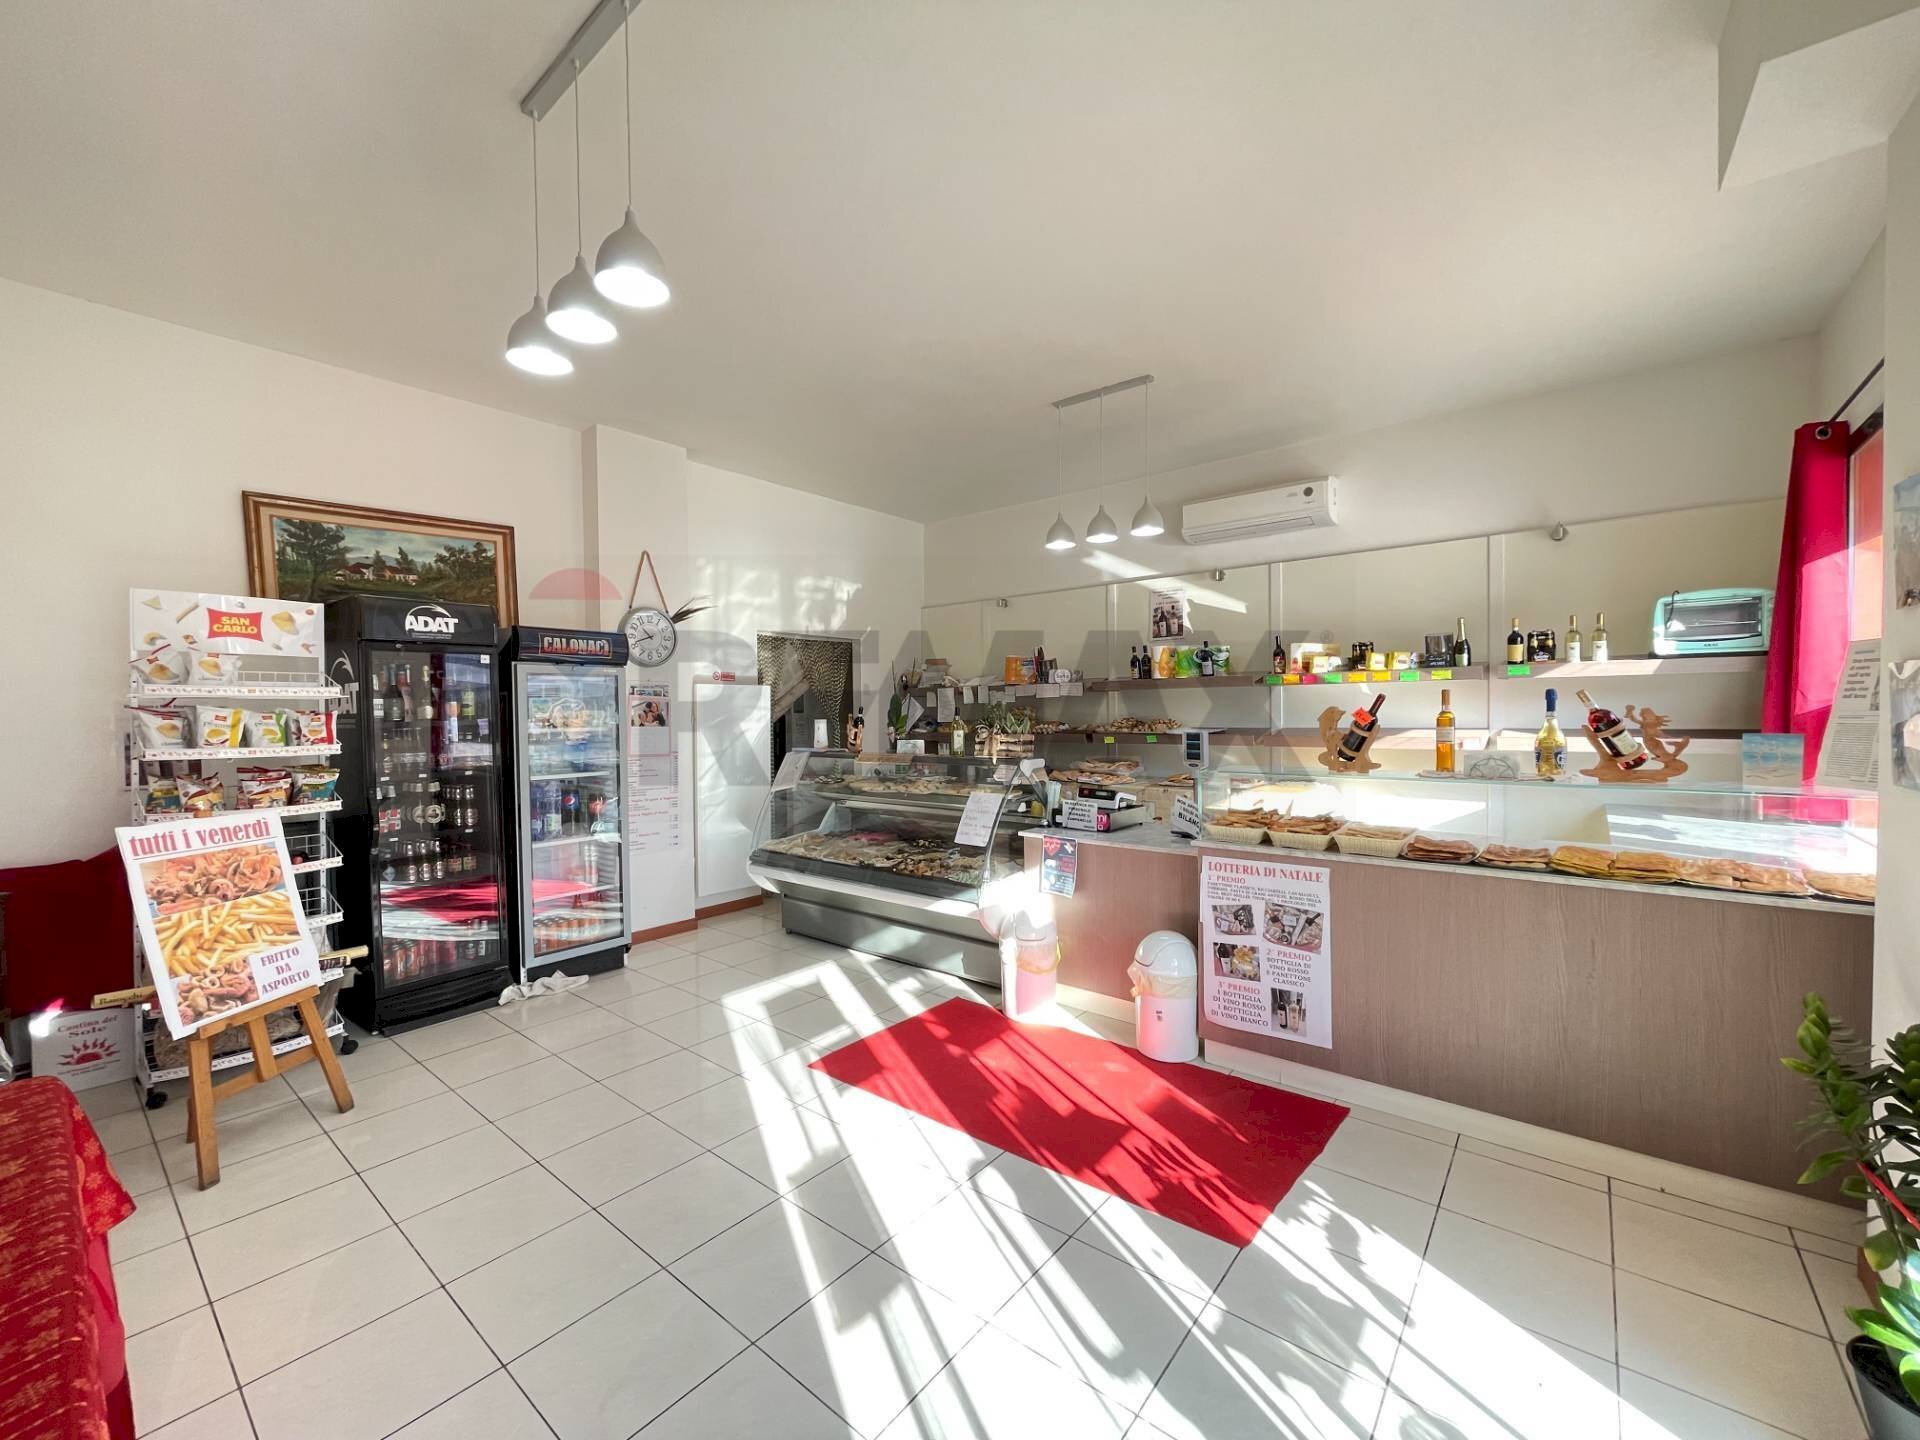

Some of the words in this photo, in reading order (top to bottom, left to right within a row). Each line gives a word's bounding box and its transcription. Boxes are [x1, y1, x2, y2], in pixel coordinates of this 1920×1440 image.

[221, 616, 250, 626] SAN
[405, 615, 459, 633] ADAT
[637, 616, 644, 625] 11
[646, 615, 654, 623] 12
[656, 617, 662, 625] 1
[212, 623, 258, 634] CARLO
[639, 649, 645, 657] 7
[648, 651, 653, 661] 6
[656, 649, 662, 658] 5
[129, 830, 178, 857] tutti
[183, 828, 192, 849] i
[196, 817, 272, 845] venerdì
[1208, 861, 1261, 877] LOTTERIA
[1264, 867, 1277, 879] DI
[1279, 869, 1324, 883] NATALE
[1216, 875, 1246, 885] PREMIO
[260, 947, 300, 967] FRITTO
[1267, 957, 1302, 967] BOTTIGLIA
[1277, 950, 1312, 962] PREMIO
[275, 963, 293, 975] DA
[1287, 967, 1309, 975] ROSSO
[262, 969, 310, 994] ASPORTO
[1272, 970, 1312, 982] PANETTONE
[1228, 983, 1260, 994] PREMIO
[1273, 978, 1305, 987] CLASSICO
[1223, 990, 1261, 1003] BOTTIGLIA
[1222, 997, 1240, 1006] VINO
[1242, 1002, 1266, 1011] ROSSO
[1223, 1005, 1261, 1018] BOTTIGLIA
[1220, 1011, 1238, 1020] VINO
[1240, 1016, 1269, 1026] BIANCO
[57, 1020, 99, 1032] Cantina
[68, 1026, 107, 1038] Sole
